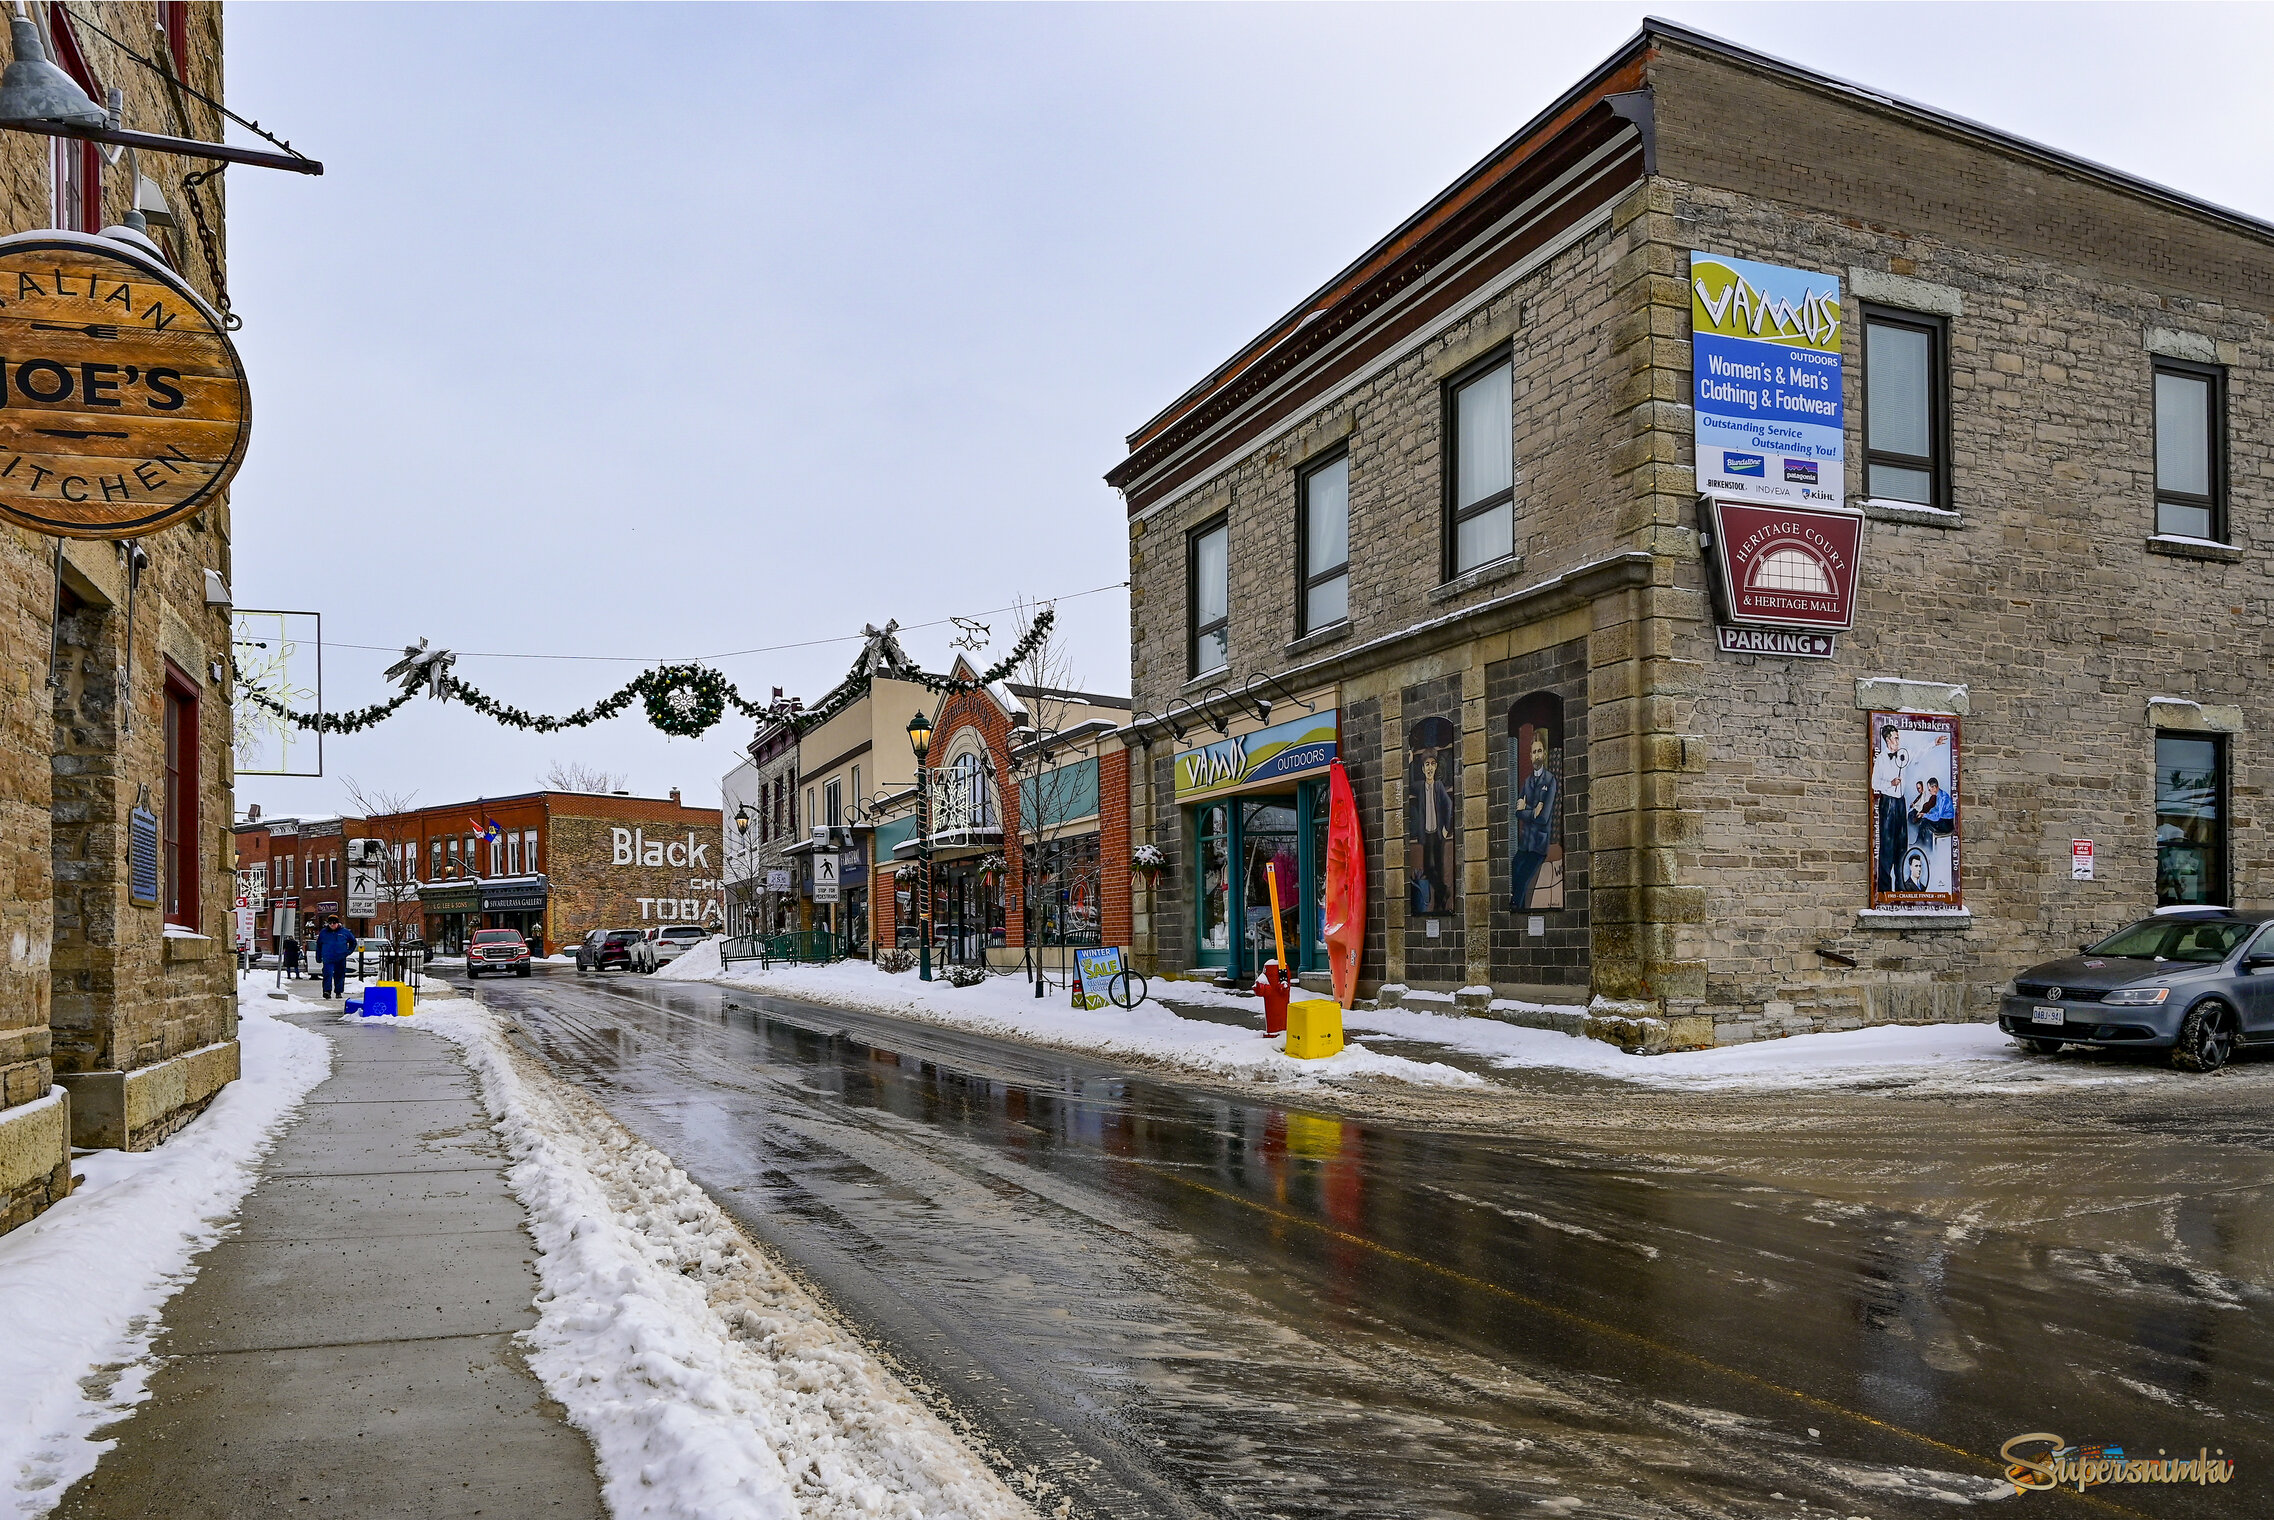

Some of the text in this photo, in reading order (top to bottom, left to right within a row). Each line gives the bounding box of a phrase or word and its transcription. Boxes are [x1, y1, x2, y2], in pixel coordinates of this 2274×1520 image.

[0, 268, 177, 332] ALIAN
[1694, 276, 1837, 346] VAMOS
[1790, 351, 1838, 367] OUTDOORS
[1708, 354, 1829, 391] Women's & Men's
[1701, 379, 1838, 417] Clothing & Footwear
[1703, 416, 1803, 439] Outstanding Service
[1751, 437, 1837, 457] Outstanding You!
[0, 443, 191, 502] ITCHEN
[1786, 472, 1816, 481] patagonia
[1736, 521, 1845, 571] HERITAGE COURT
[1743, 594, 1840, 613] & HERITAGE MALL
[1725, 629, 1811, 653] PARKING
[1881, 715, 1950, 731] The Hayshakers
[1185, 735, 1325, 788] VAMOS OUTDOORS
[610, 827, 710, 869] Black
[1081, 948, 1111, 958] WINTER
[1083, 960, 1120, 979] SALE
